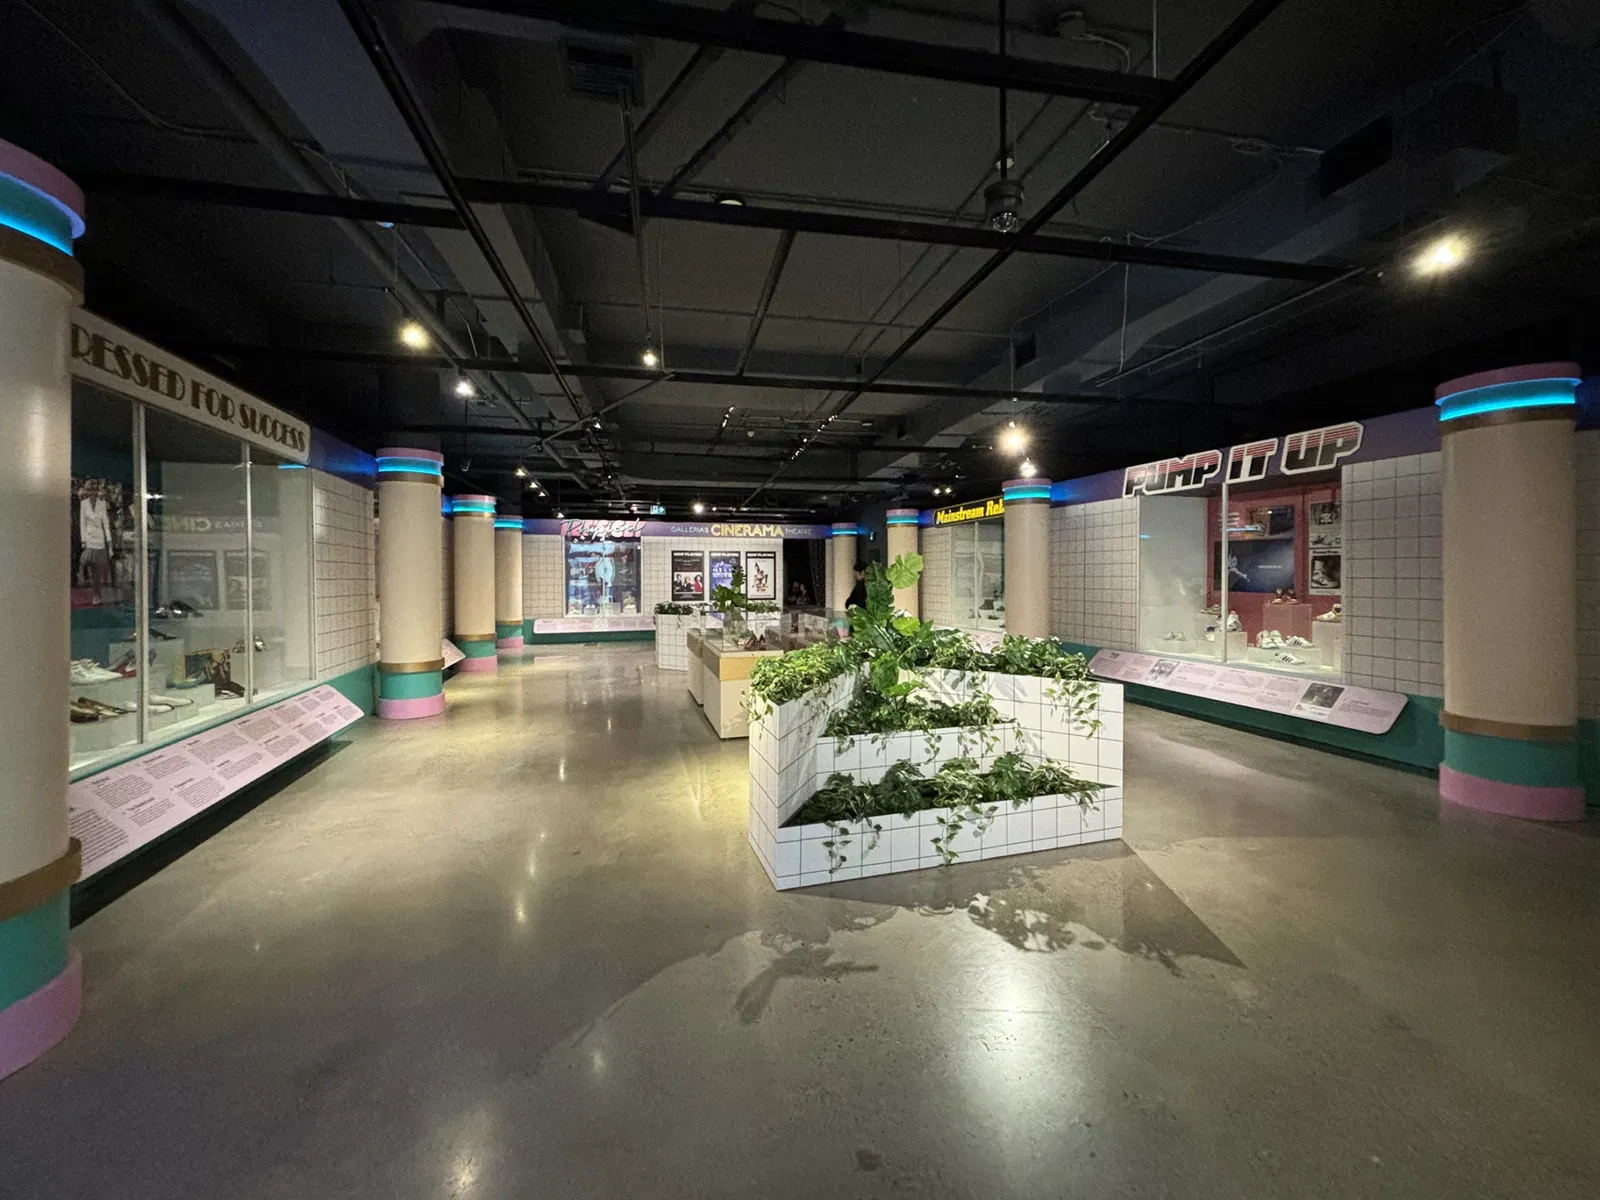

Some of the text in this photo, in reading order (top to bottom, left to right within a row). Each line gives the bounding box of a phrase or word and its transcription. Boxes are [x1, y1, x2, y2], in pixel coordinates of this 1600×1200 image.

[191, 379, 235, 425] FOR
[239, 403, 306, 453] SUCCESS
[1122, 421, 1364, 499] PUMP IT UP
[710, 523, 784, 537] CINERAMA
[935, 506, 985, 525] Mainstream
